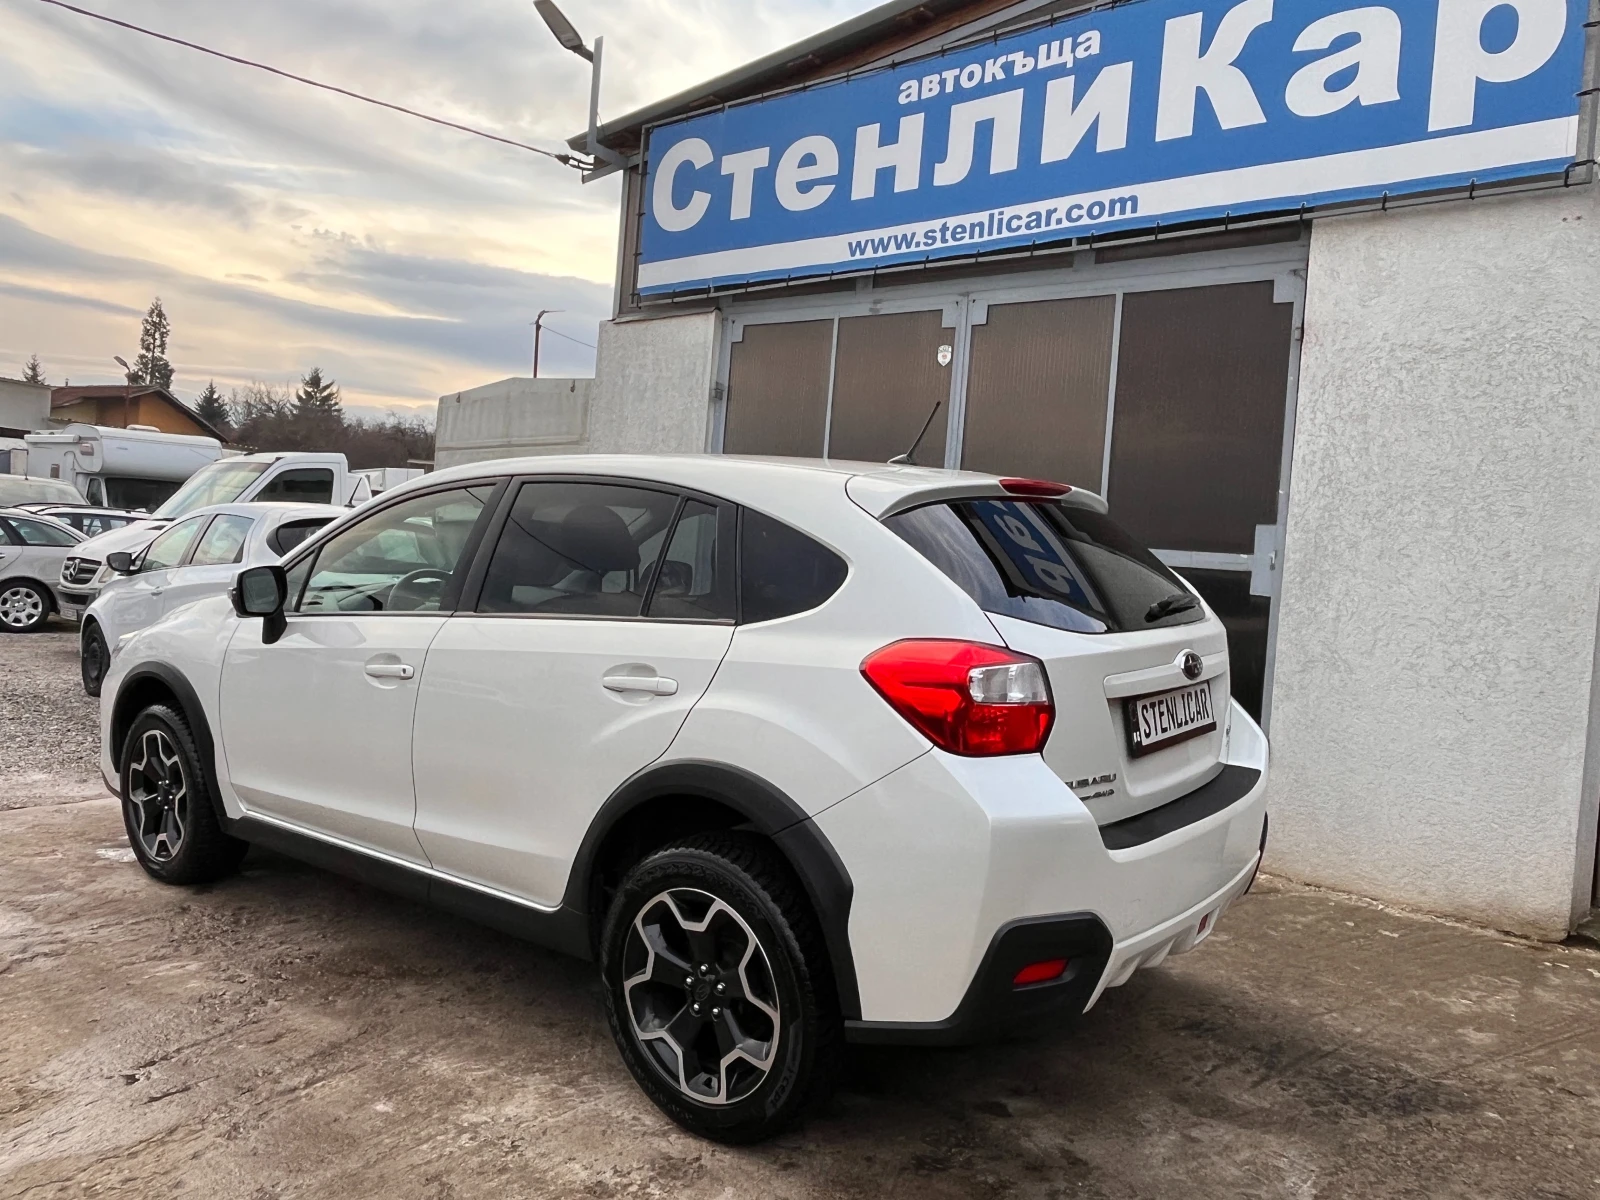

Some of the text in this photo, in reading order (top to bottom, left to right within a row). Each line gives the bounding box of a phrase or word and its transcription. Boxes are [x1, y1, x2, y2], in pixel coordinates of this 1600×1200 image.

[898, 30, 1102, 104] автокъща
[848, 192, 1139, 258] www.stenlicar.com
[1140, 687, 1210, 739] STENLICAR
